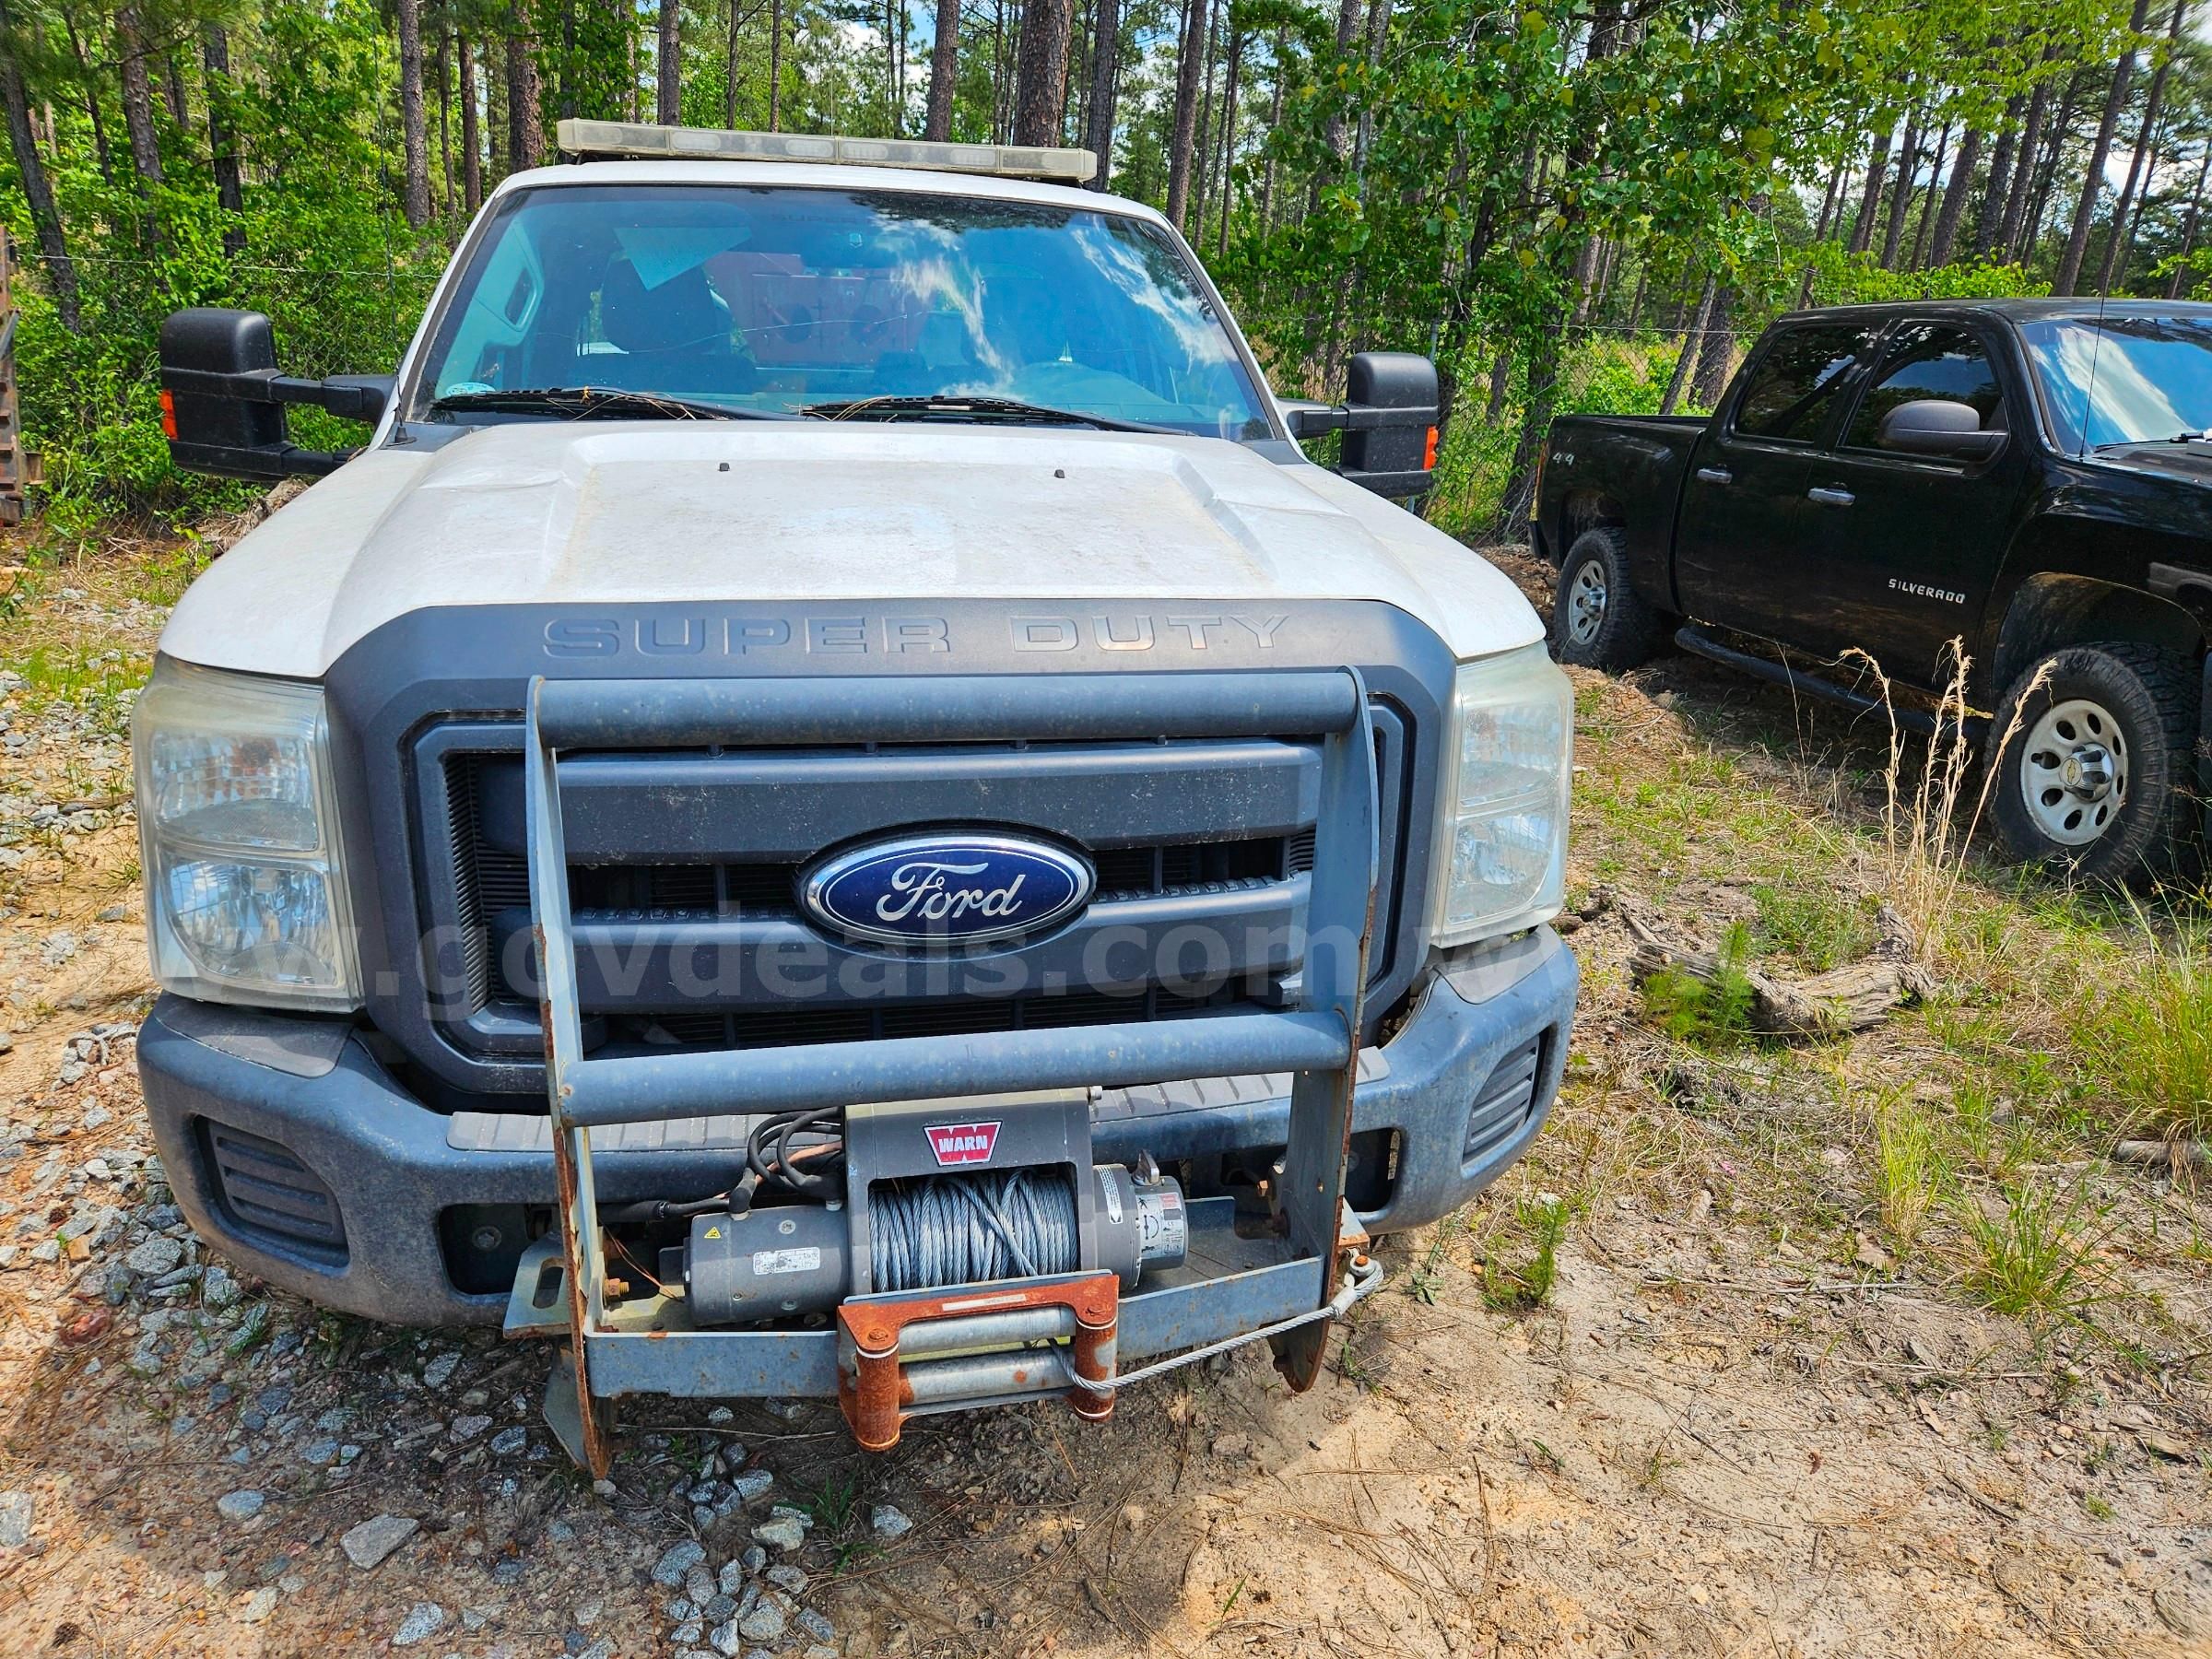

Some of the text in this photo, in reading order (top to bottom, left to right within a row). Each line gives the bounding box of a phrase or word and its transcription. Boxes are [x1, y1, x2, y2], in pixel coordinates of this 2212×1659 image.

[1888, 578, 1966, 604] SILVERADO
[542, 614, 1289, 657] SUPER DUTY
[876, 862, 1026, 922] Ford
[937, 1135, 988, 1153] WARN
